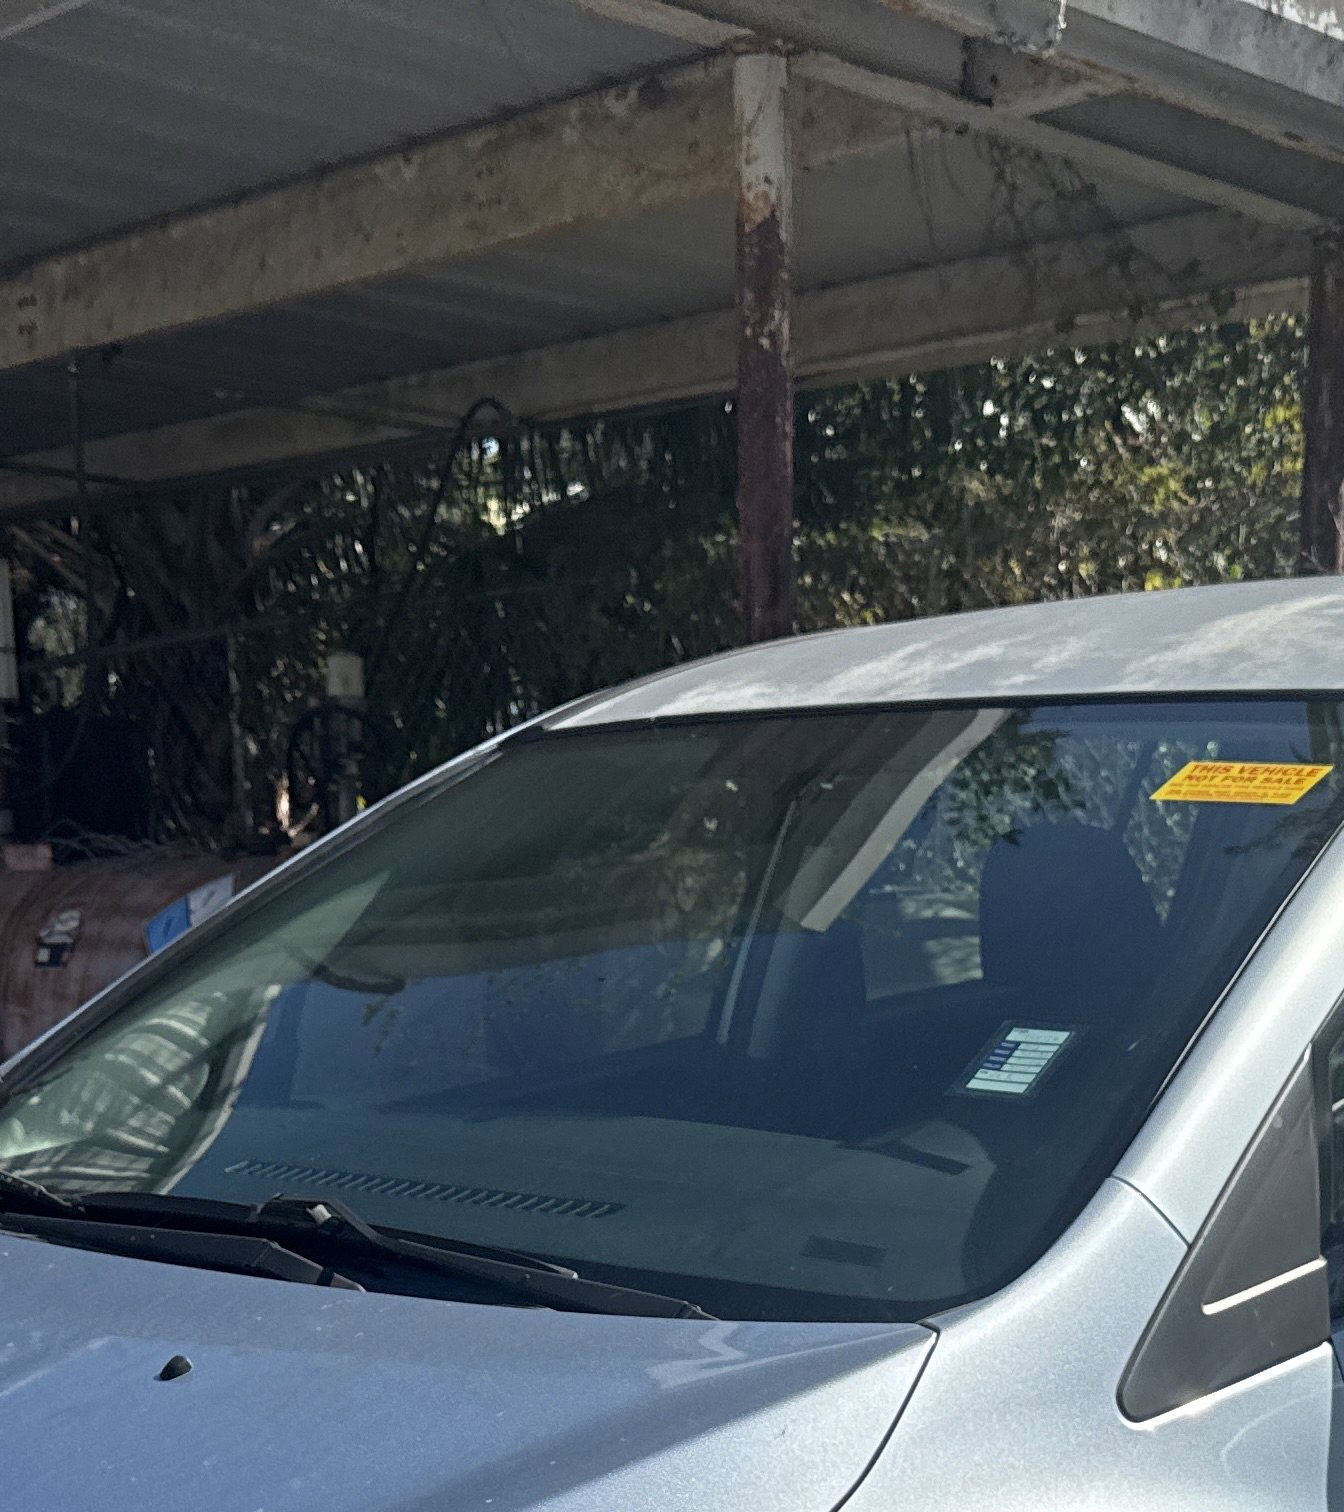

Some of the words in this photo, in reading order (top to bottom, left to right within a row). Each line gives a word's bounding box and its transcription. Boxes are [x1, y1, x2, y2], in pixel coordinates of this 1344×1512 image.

[1190, 765, 1234, 774] THIS
[1238, 766, 1323, 777] VEHICLE
[1184, 775, 1218, 783] NOT
[1220, 776, 1258, 784] FOR
[1259, 777, 1307, 786] SALE
